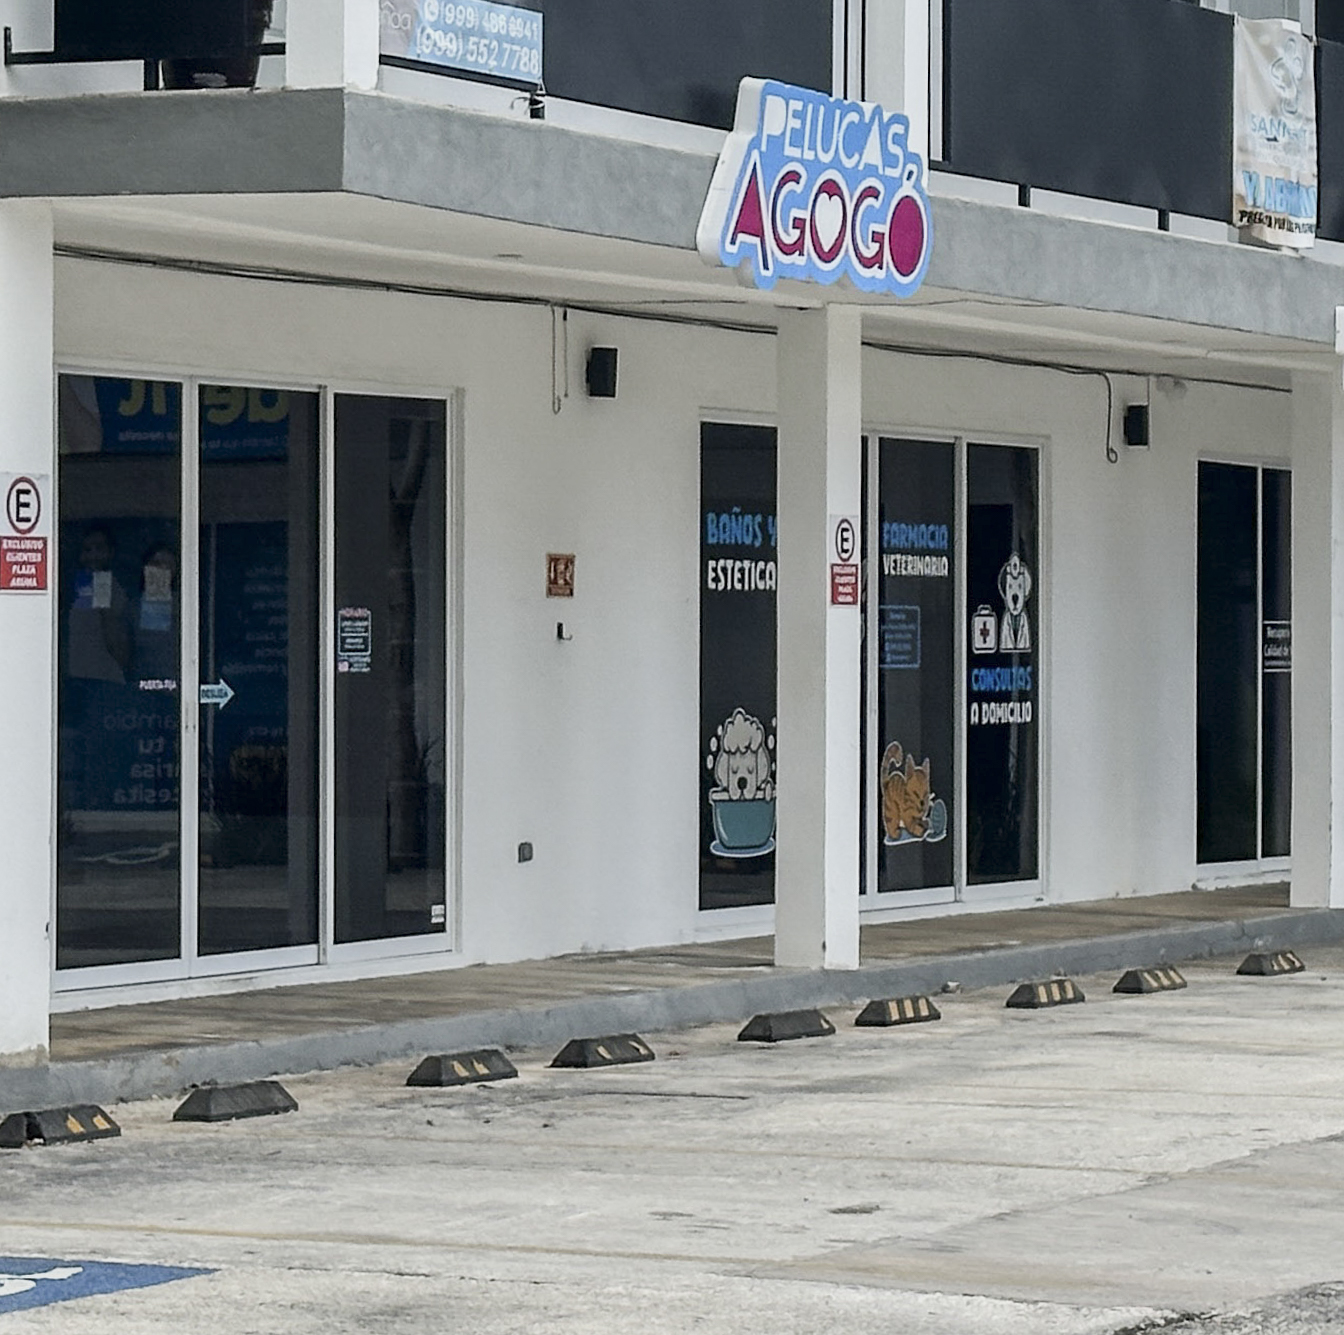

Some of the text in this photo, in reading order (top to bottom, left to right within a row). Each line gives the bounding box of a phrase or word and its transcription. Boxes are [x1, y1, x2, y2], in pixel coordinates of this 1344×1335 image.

[466, 35, 498, 67] 552
[501, 42, 541, 75] 7788
[16, 488, 32, 523] E
[707, 506, 762, 548] BAÑOS
[841, 527, 850, 554] E
[883, 523, 948, 550] FARMACIA
[708, 559, 776, 591] ESTETICA
[883, 554, 948, 577] VETERINARIA
[972, 666, 1032, 691] CONSULTAS
[970, 701, 1032, 725] A DOMICILIO
